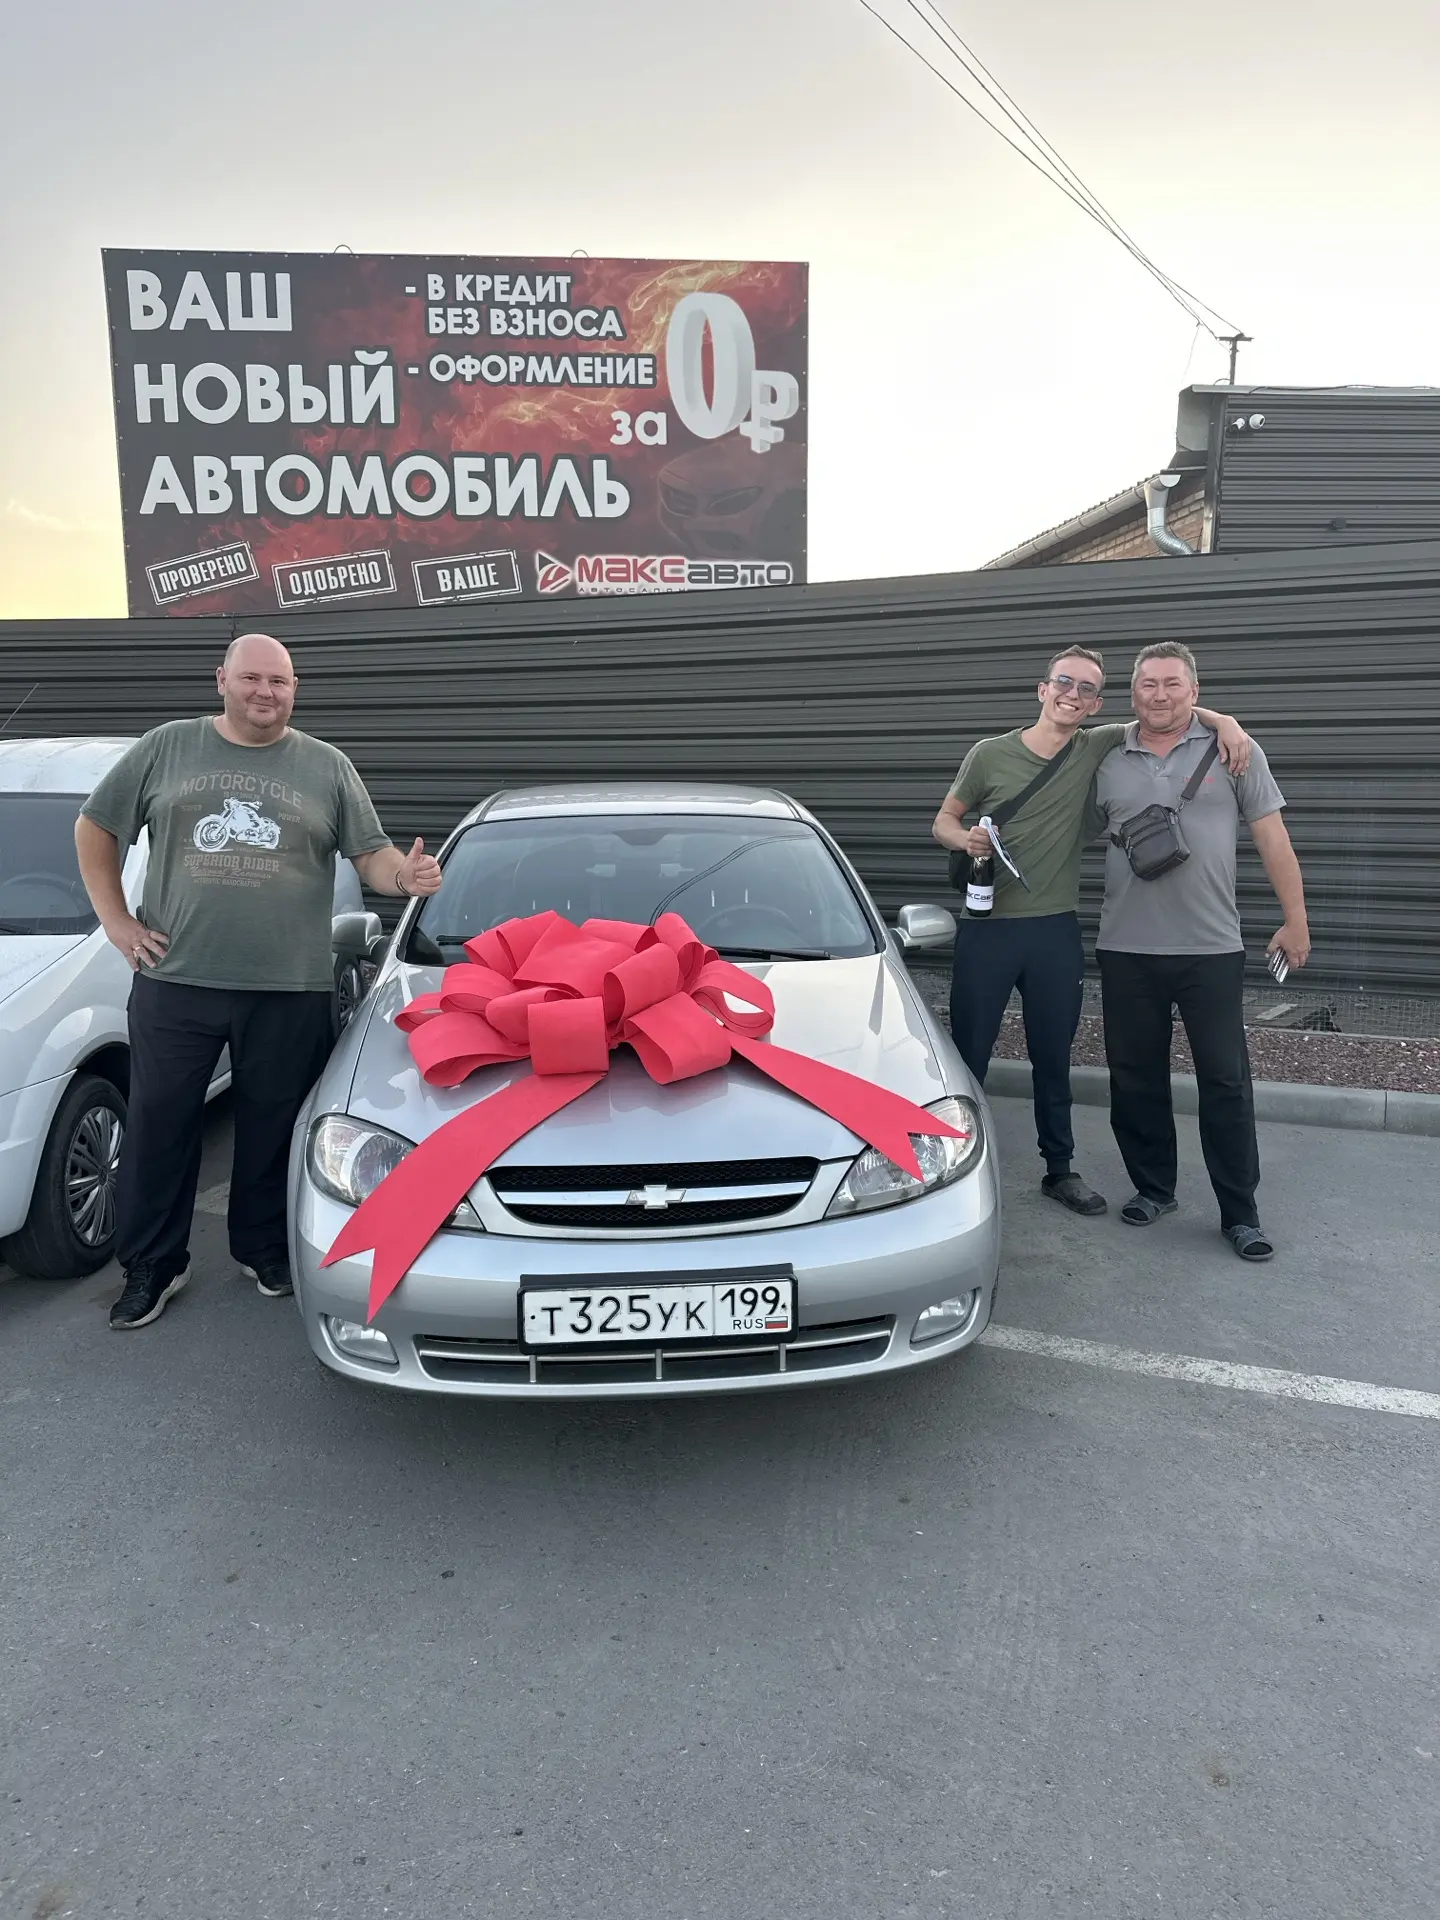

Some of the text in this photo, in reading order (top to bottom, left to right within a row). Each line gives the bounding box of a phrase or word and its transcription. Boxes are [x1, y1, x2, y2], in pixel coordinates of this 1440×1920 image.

[126, 269, 292, 331] ВАШ
[427, 273, 445, 301] В
[455, 275, 571, 305] КРЕДИТ
[428, 307, 623, 337] БЕЗ ВЗНОСА
[429, 353, 655, 385] ОФОРМЛЕНИЕ
[133, 350, 395, 424] НОВЫЙ
[139, 454, 631, 517] АВТОМОБИЛЬ
[158, 552, 248, 593] ПРОВЕРЕНО
[289, 561, 382, 596] ОДОБРЕНО
[436, 563, 500, 593] ВАШЕ
[179, 773, 302, 810] MOTORCYCLE
[278, 812, 301, 824] POWER
[184, 854, 280, 873] SUPERIOR RIDER
[541, 1285, 781, 1336] Т325УК 199
[733, 1318, 764, 1330] RUS
